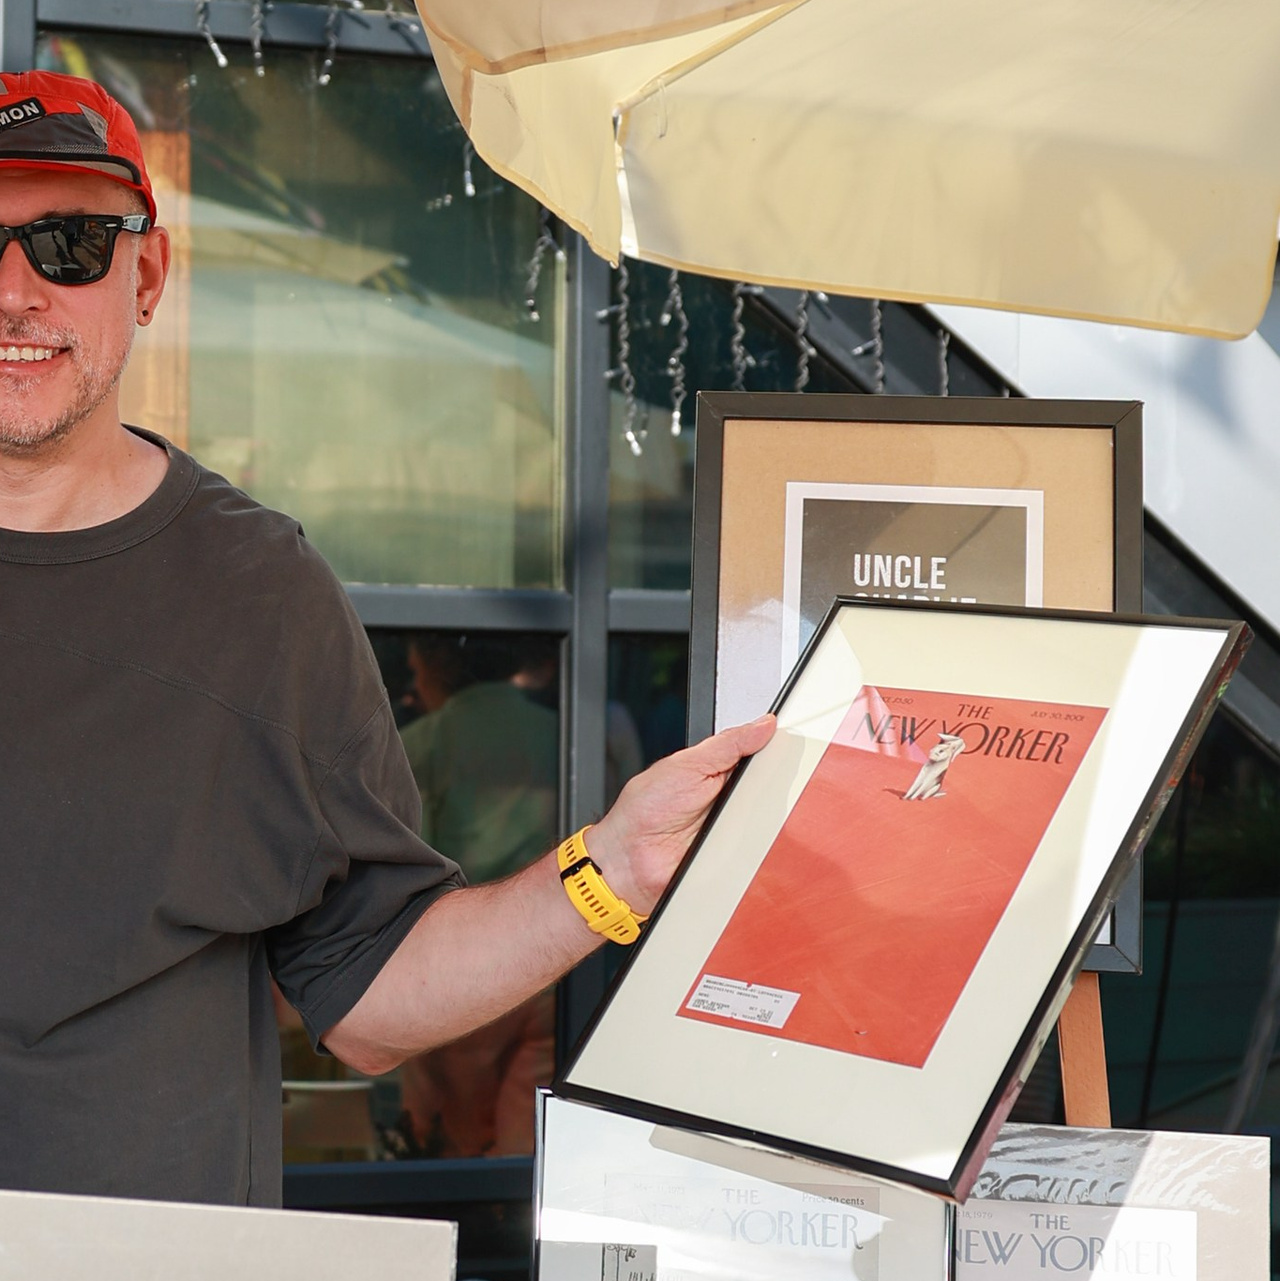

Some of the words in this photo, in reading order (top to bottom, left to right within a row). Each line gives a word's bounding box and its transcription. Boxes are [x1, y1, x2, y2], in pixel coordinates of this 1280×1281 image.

[853, 553, 947, 590] UNCLE
[957, 703, 994, 720] THE
[852, 712, 937, 746] NEW
[941, 720, 1070, 765] YORKER
[721, 1188, 761, 1206] THE
[720, 1208, 864, 1250] YORKER
[1029, 1213, 1071, 1231] THE
[1030, 1232, 1178, 1277] YORKER
